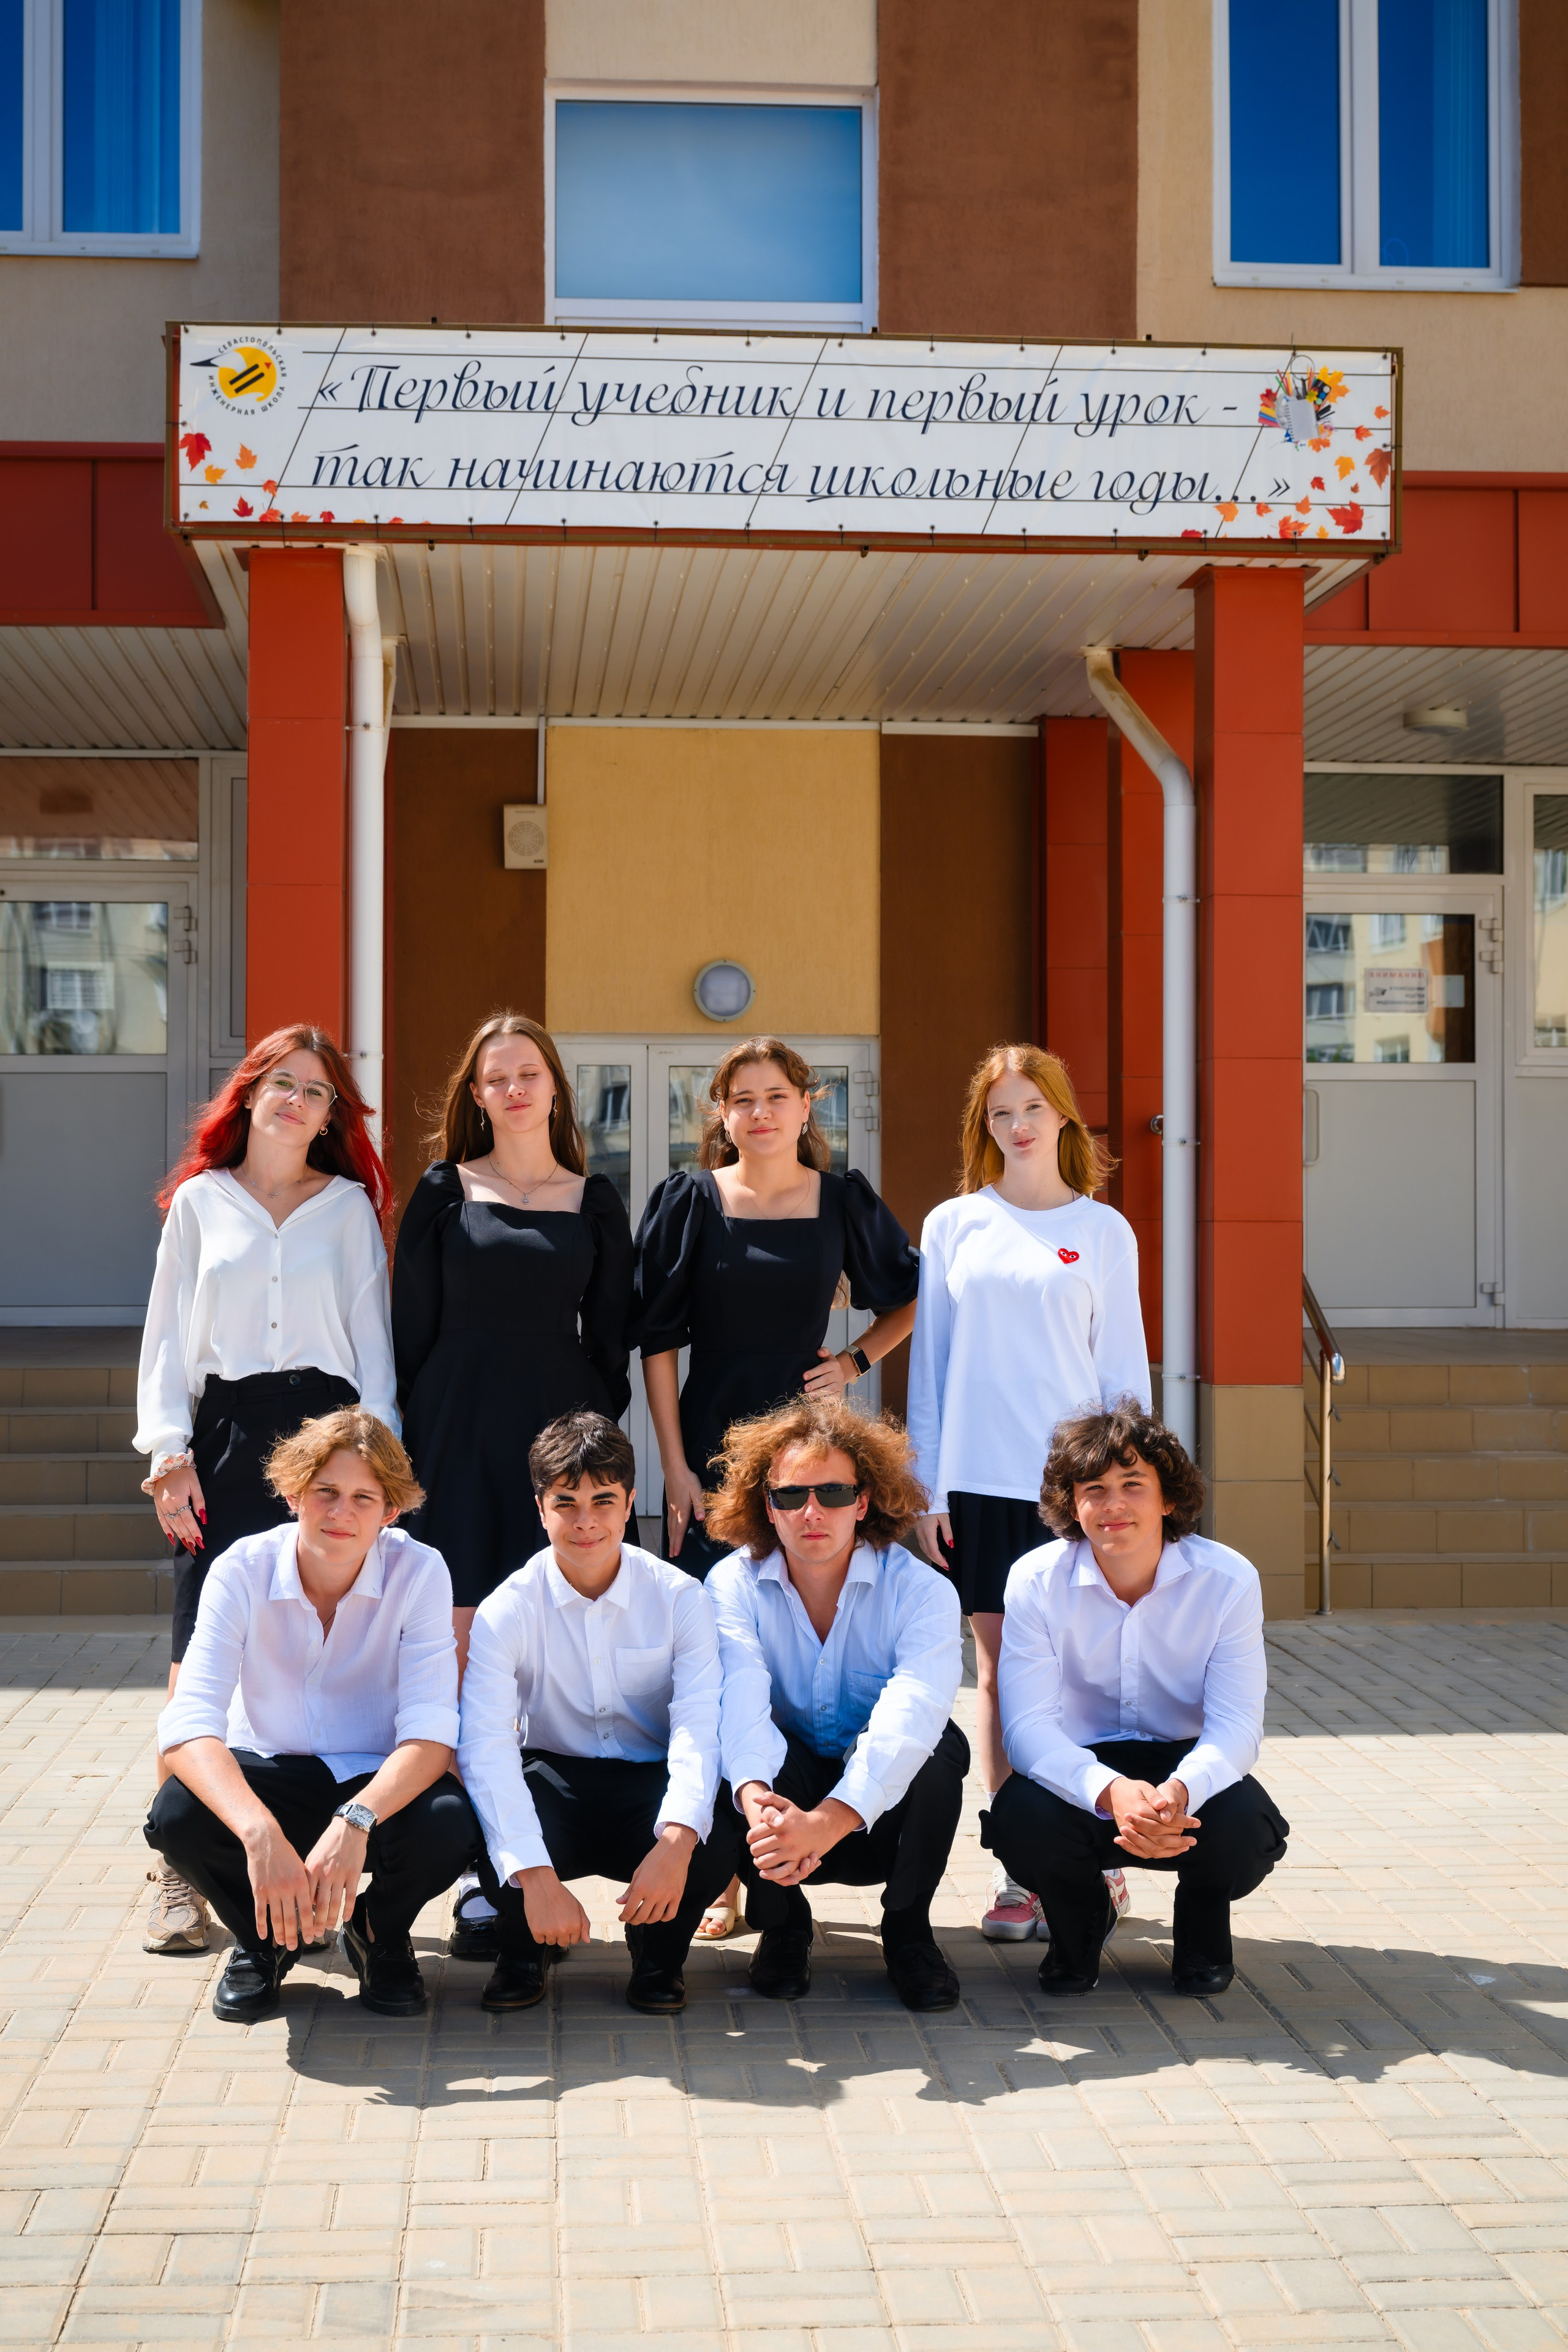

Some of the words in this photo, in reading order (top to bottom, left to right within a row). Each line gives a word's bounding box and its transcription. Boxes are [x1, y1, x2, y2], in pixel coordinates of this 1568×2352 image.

[218, 337, 287, 377] СЕВАСТОПОЛЬСКАЯ
[208, 375, 256, 415] ИНЖЕНЕРНАЯ
[261, 386, 285, 413] ШКОЛА
[318, 360, 565, 423] «Первый
[571, 366, 804, 427] учебник
[816, 388, 856, 418] и
[867, 372, 1068, 435] первый
[1074, 393, 1210, 437] урок
[312, 443, 435, 488] так
[447, 451, 799, 494] начинаются
[805, 466, 1080, 502] школьные
